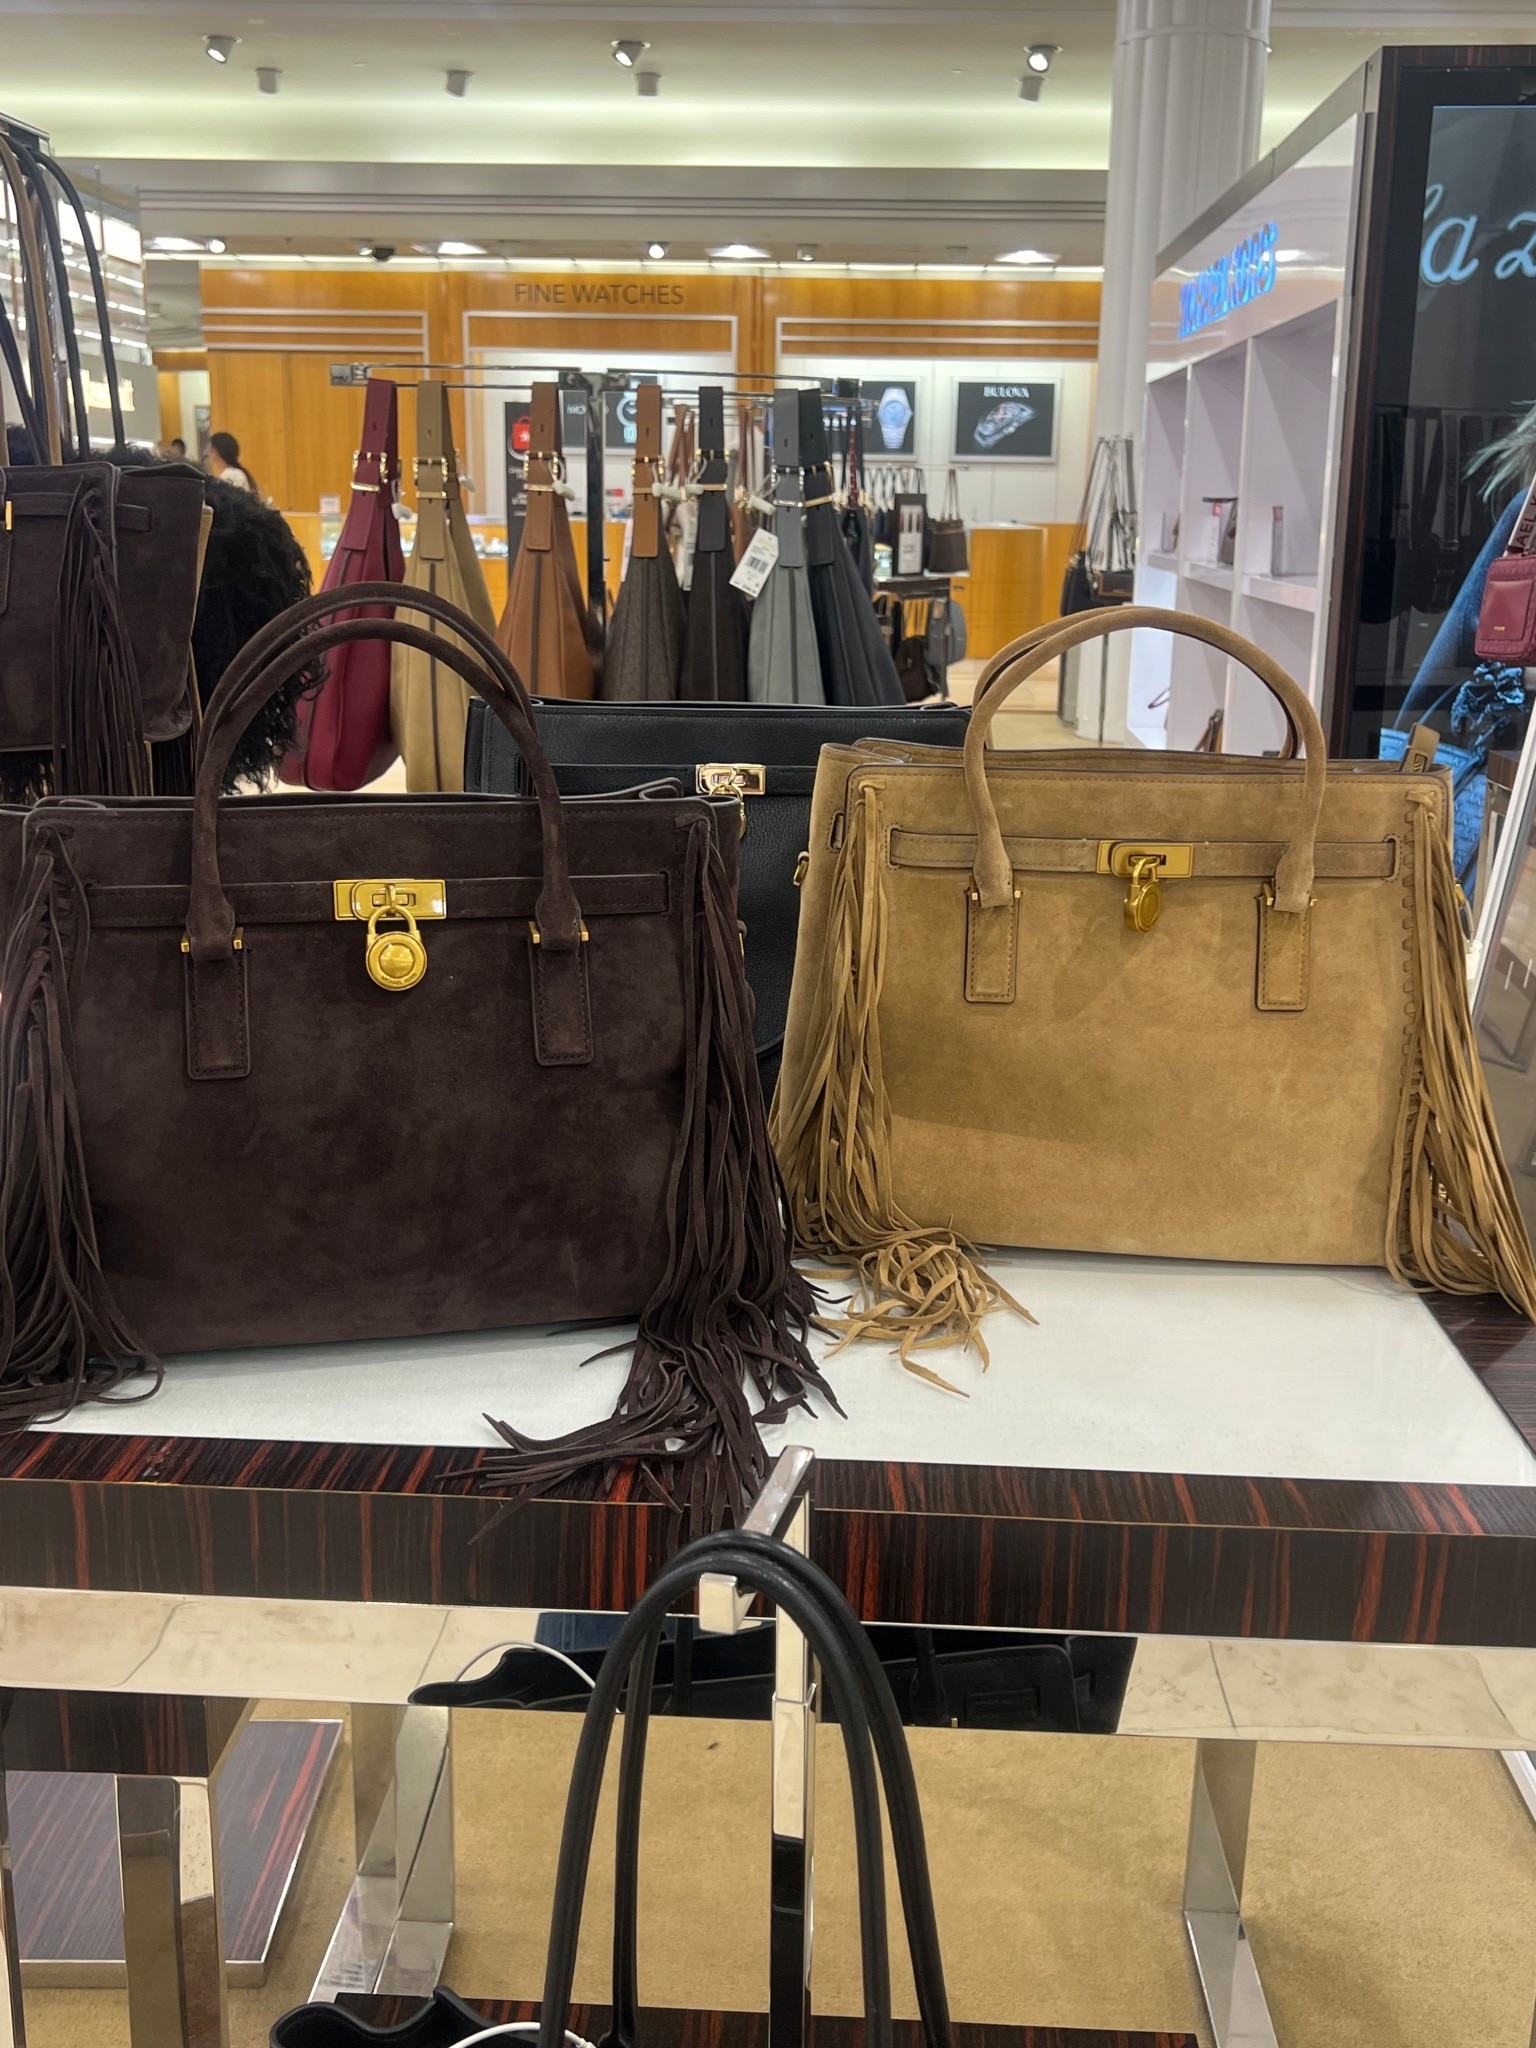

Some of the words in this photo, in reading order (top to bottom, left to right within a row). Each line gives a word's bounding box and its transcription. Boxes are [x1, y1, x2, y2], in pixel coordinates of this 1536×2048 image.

[514, 283, 566, 303] FINE
[570, 284, 685, 305] WATCHES
[983, 386, 1029, 398] BULOVA
